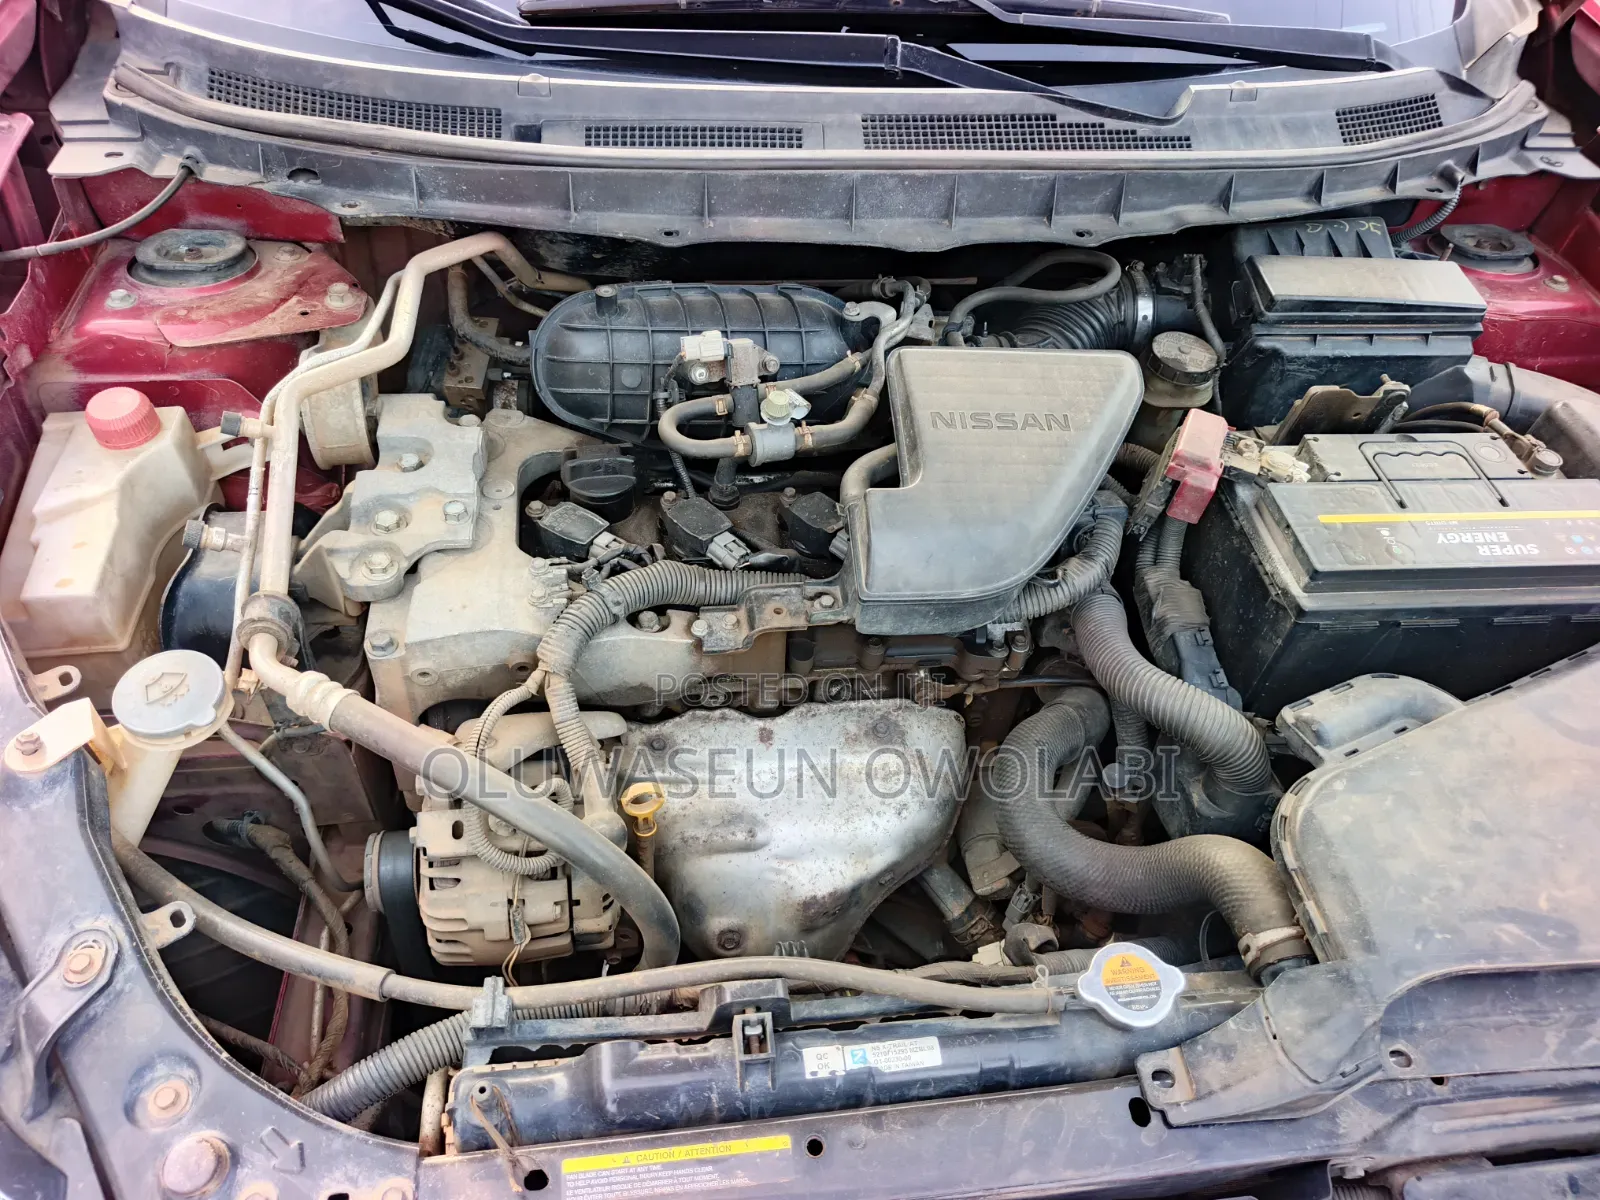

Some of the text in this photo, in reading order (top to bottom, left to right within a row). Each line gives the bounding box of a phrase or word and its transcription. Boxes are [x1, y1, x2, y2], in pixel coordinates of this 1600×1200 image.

[930, 411, 1072, 432] NISSAN
[1436, 531, 1510, 544] ENERGY
[1477, 543, 1541, 556] SUPER
[1110, 966, 1146, 976] WARNING
[815, 1052, 829, 1061] QC
[816, 1062, 831, 1070] OK
[636, 1151, 675, 1163] CAUTION
[685, 1144, 732, 1157] ATTENTION
[611, 1168, 628, 1176] START
[575, 1179, 590, 1187] HELP
[590, 1177, 608, 1185] AVOID
